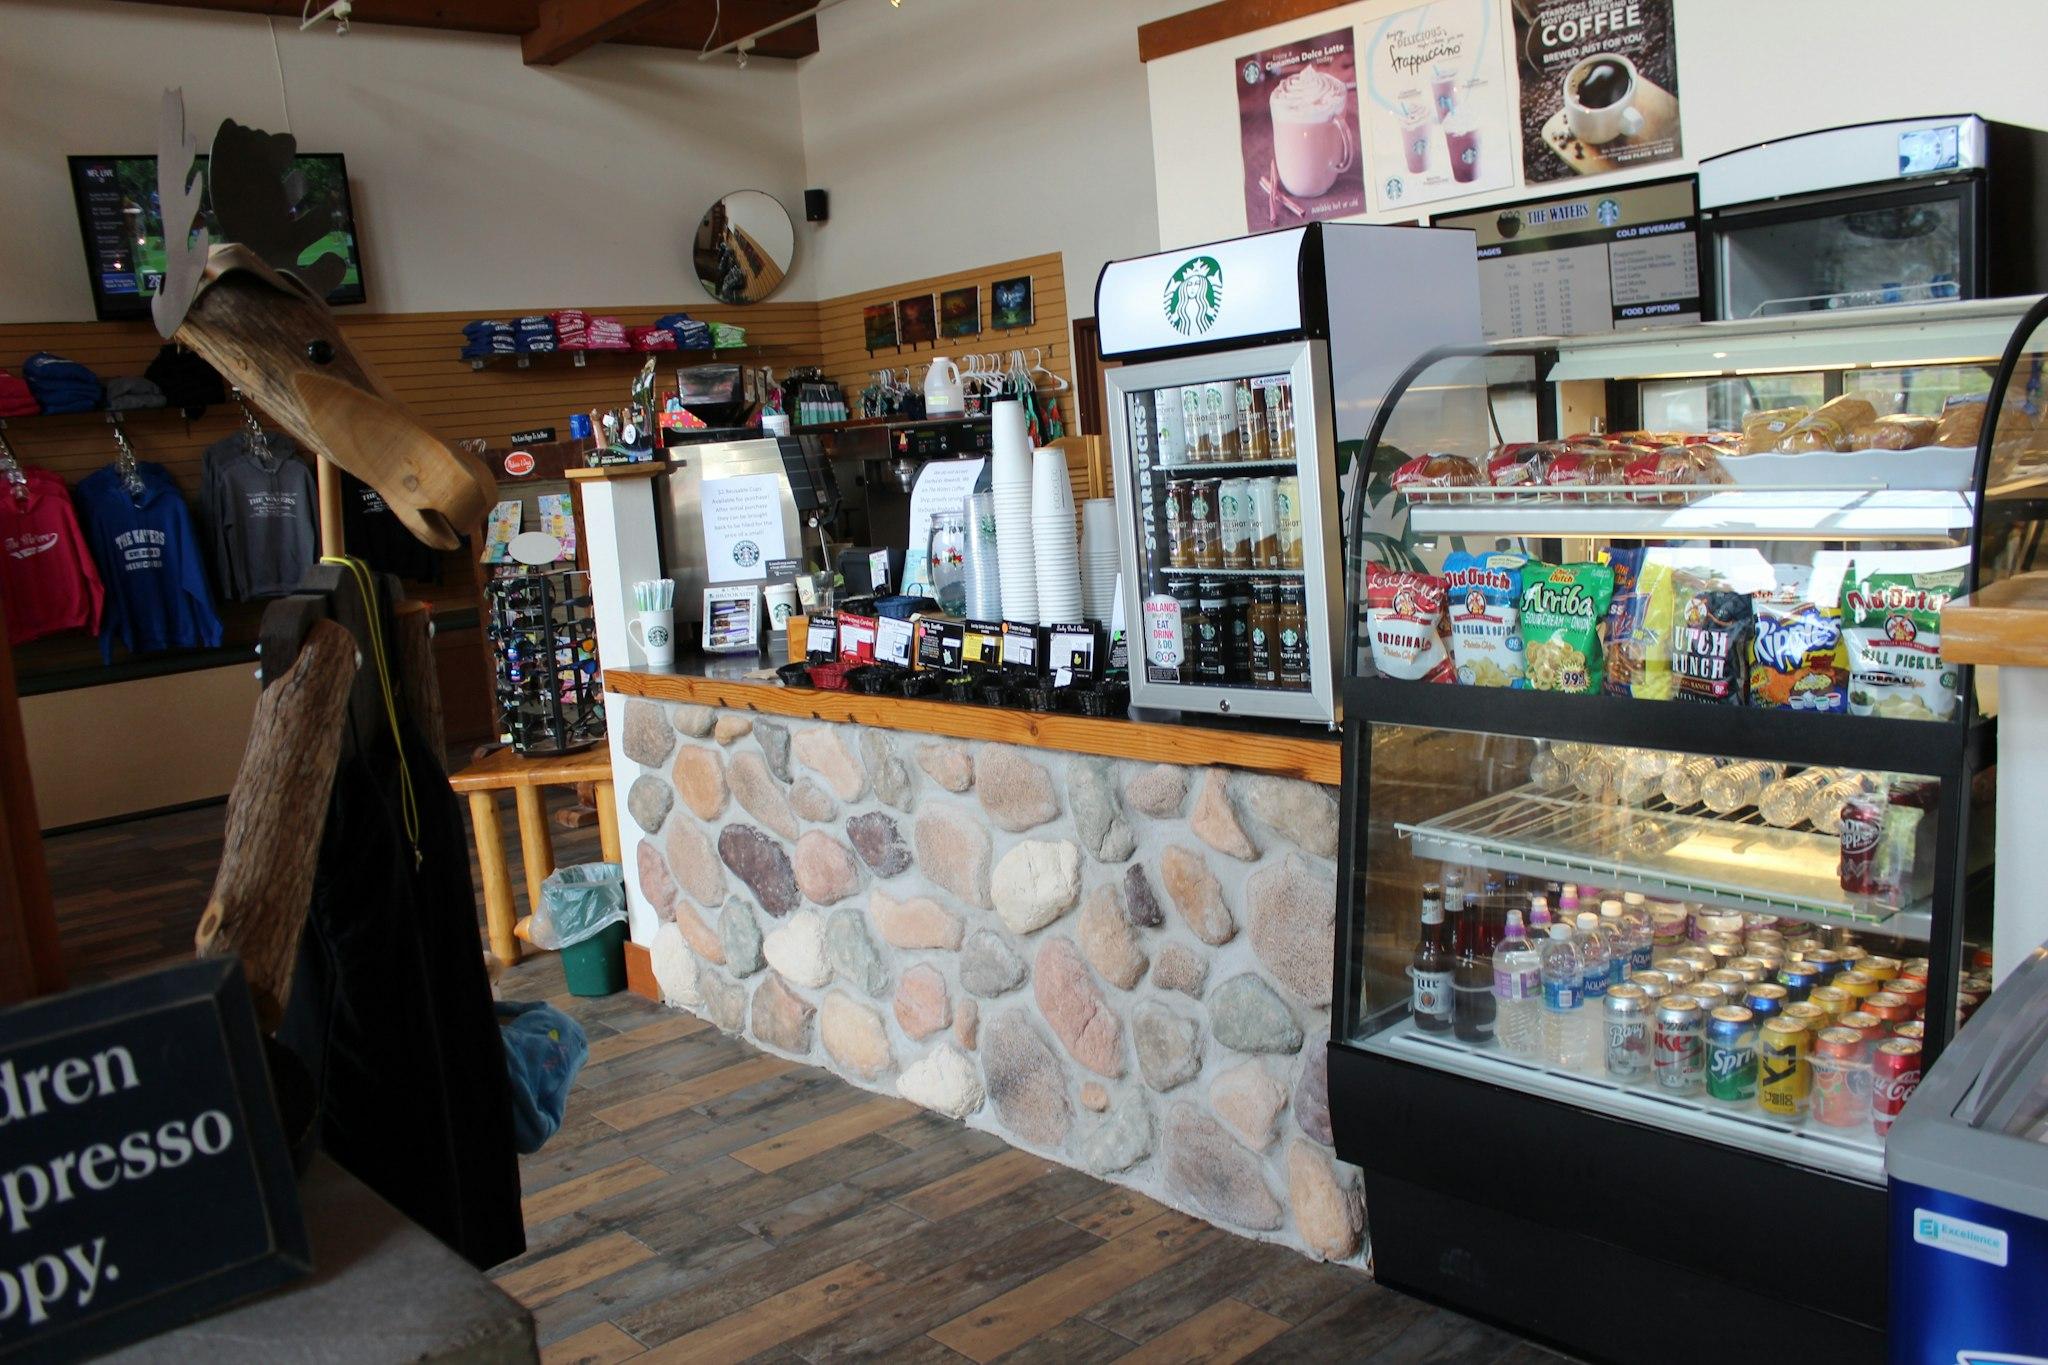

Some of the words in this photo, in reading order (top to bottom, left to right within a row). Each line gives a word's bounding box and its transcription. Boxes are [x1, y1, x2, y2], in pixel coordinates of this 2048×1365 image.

[1540, 2, 1586, 19] STARBUCKS
[1541, 16, 1563, 27] MOST
[1564, 9, 1600, 21] POPULAR
[1266, 55, 1300, 70] Cinnamon
[1301, 50, 1322, 62] Dolce
[1324, 44, 1345, 56] Latte
[1543, 48, 1579, 63] BREWED
[1581, 42, 1601, 55] JUST
[1603, 38, 1620, 50] FOR
[1527, 208, 1547, 224] THE
[1550, 202, 1590, 221] WATERS
[1616, 228, 1637, 238] COLD
[1638, 221, 1687, 235] BEVERAGES
[1622, 306, 1644, 317] FOOD
[1645, 303, 1680, 314] OPTIONS
[1134, 405, 1157, 550] STARBUCKS
[115, 532, 133, 550] THE
[131, 529, 165, 546] WATERS
[1468, 567, 1512, 589] Dutch
[1145, 602, 1178, 613] BALANCE
[1521, 582, 1595, 617] Arriba
[1156, 619, 1169, 630] EAT
[1462, 624, 1484, 636] CREAM
[1153, 630, 1174, 640] DRINK
[1895, 655, 1944, 670] PICKLE
[0, 1109, 233, 1234] presso
[1941, 1224, 2000, 1248] Excellence
